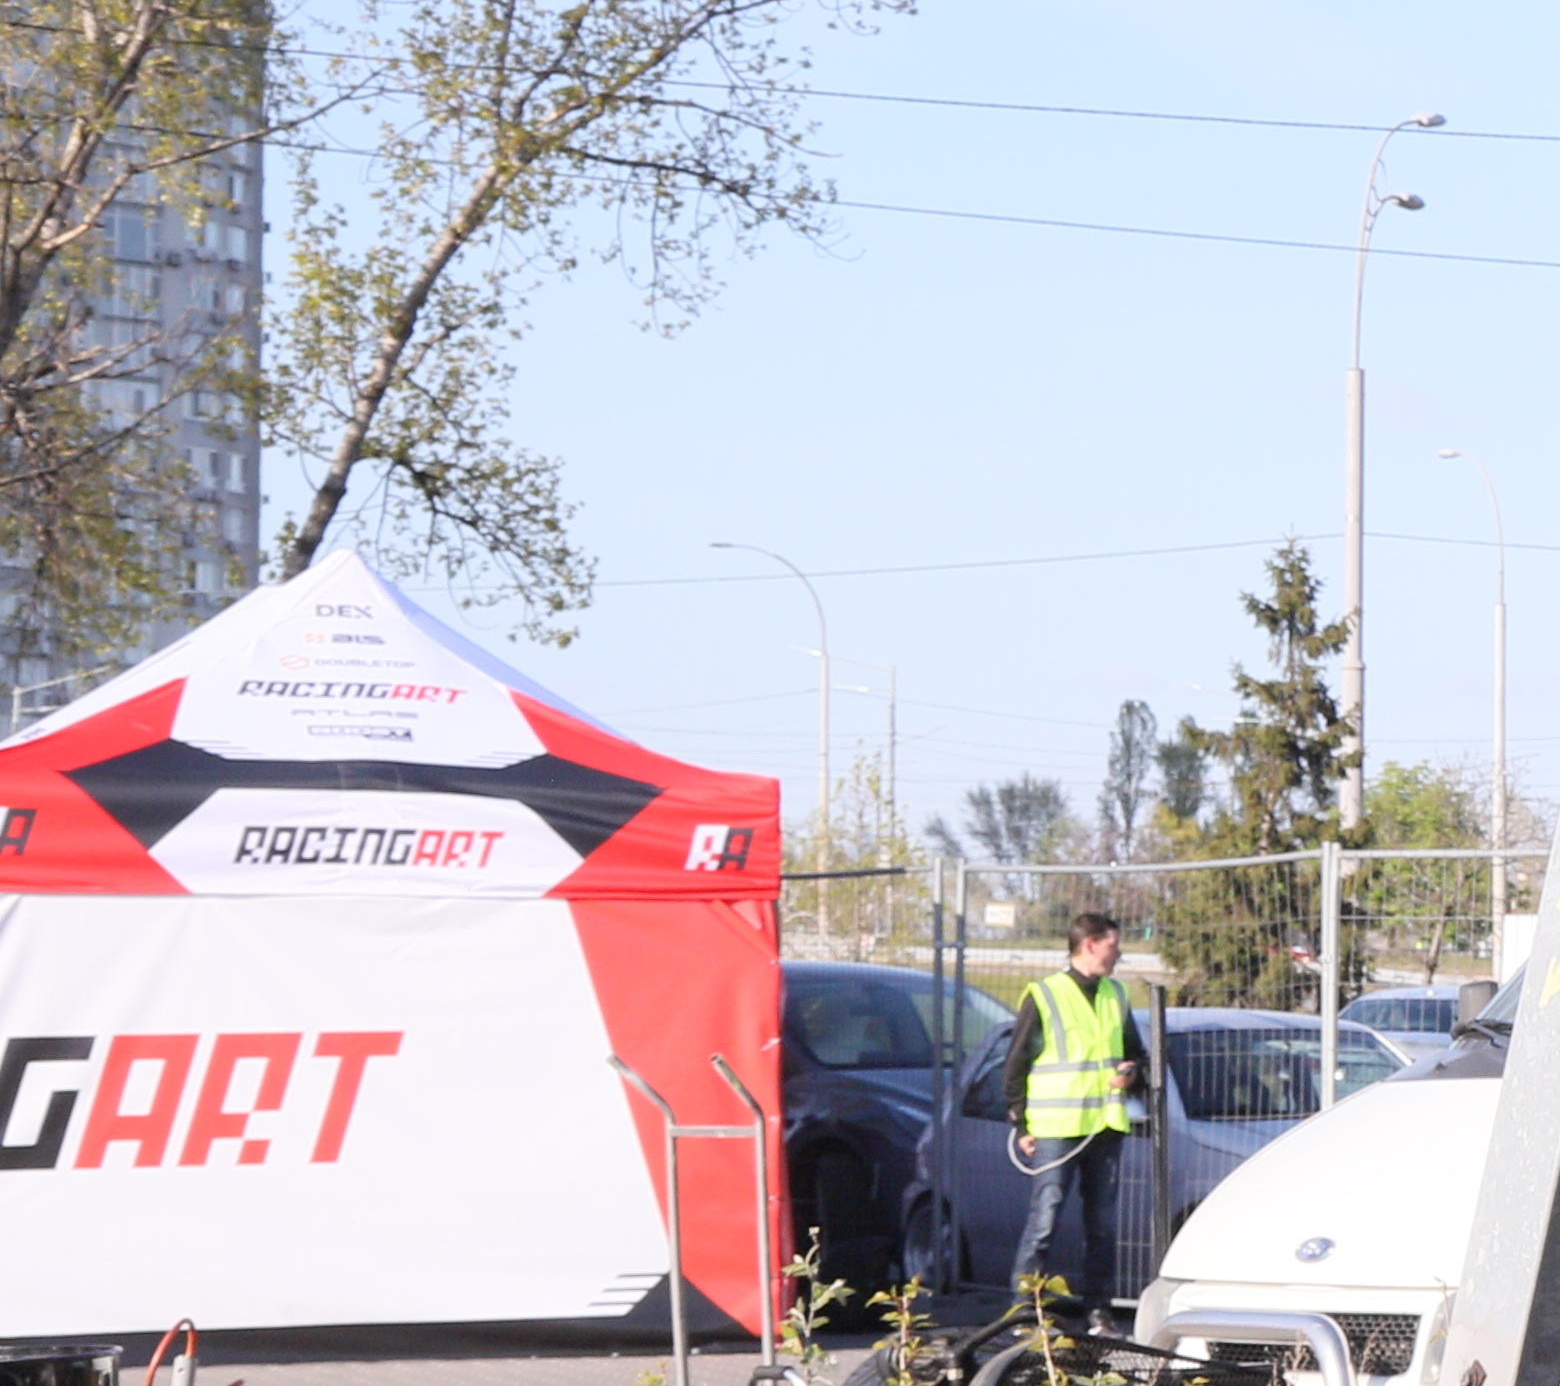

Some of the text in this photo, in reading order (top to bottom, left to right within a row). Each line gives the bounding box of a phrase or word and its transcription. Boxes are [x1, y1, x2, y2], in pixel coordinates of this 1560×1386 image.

[315, 603, 374, 620] DEX
[237, 679, 468, 704] RACINGART
[233, 824, 506, 870] RACINGART
[684, 823, 757, 872] RA
